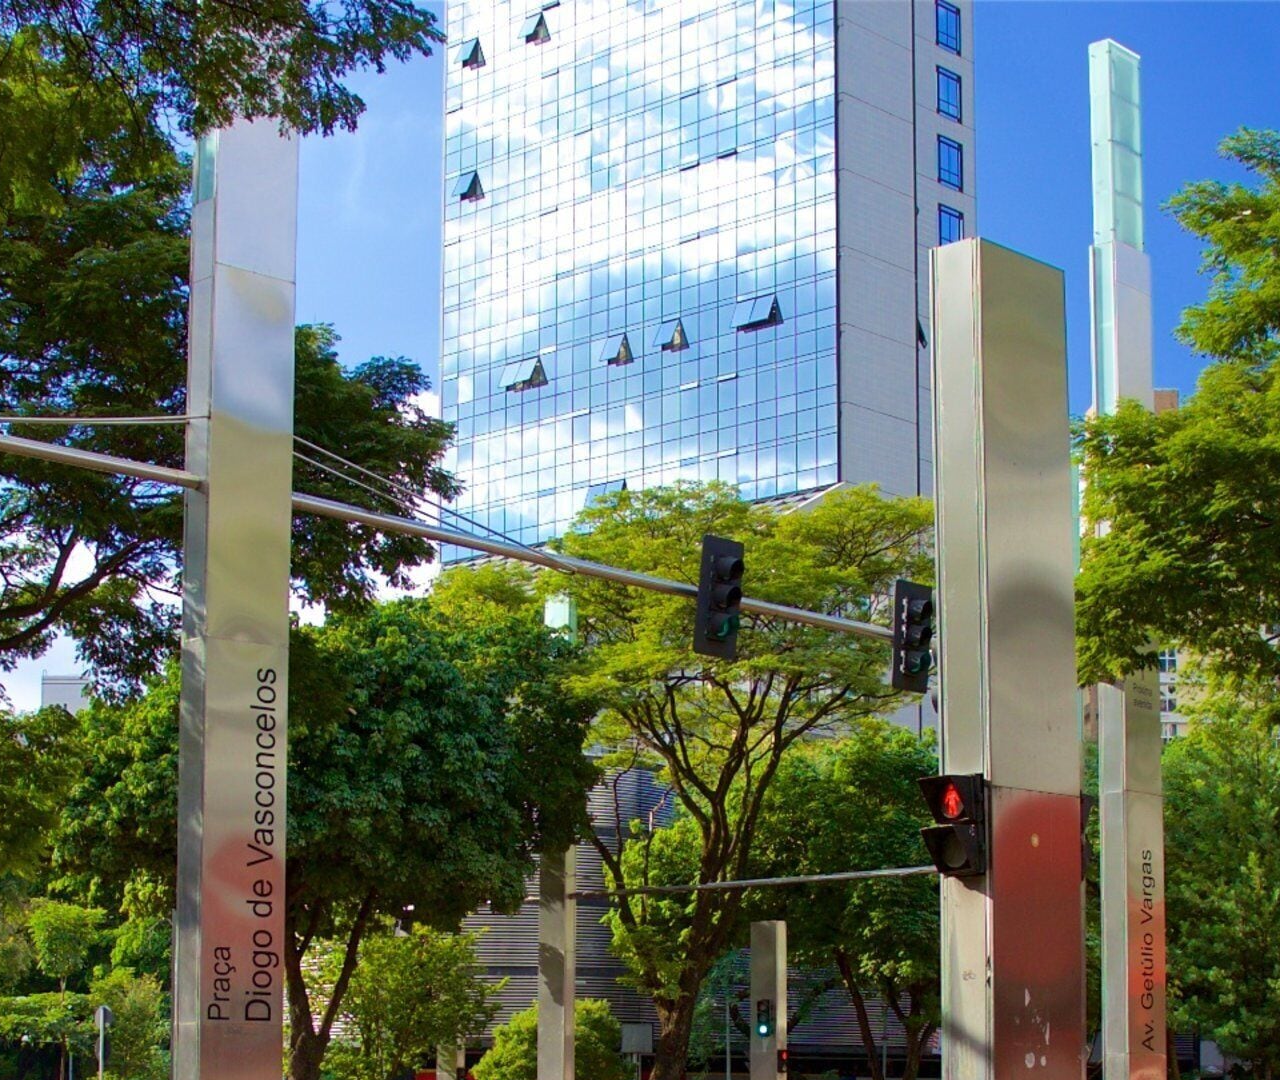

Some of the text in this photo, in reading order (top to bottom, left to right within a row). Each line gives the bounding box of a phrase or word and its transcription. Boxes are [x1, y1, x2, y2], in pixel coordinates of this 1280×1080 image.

[245, 667, 279, 1022] Diogo de Vasconcelos
[208, 945, 236, 1021] Praça
[1140, 850, 1155, 1051] Av. Getúlio Vargas
